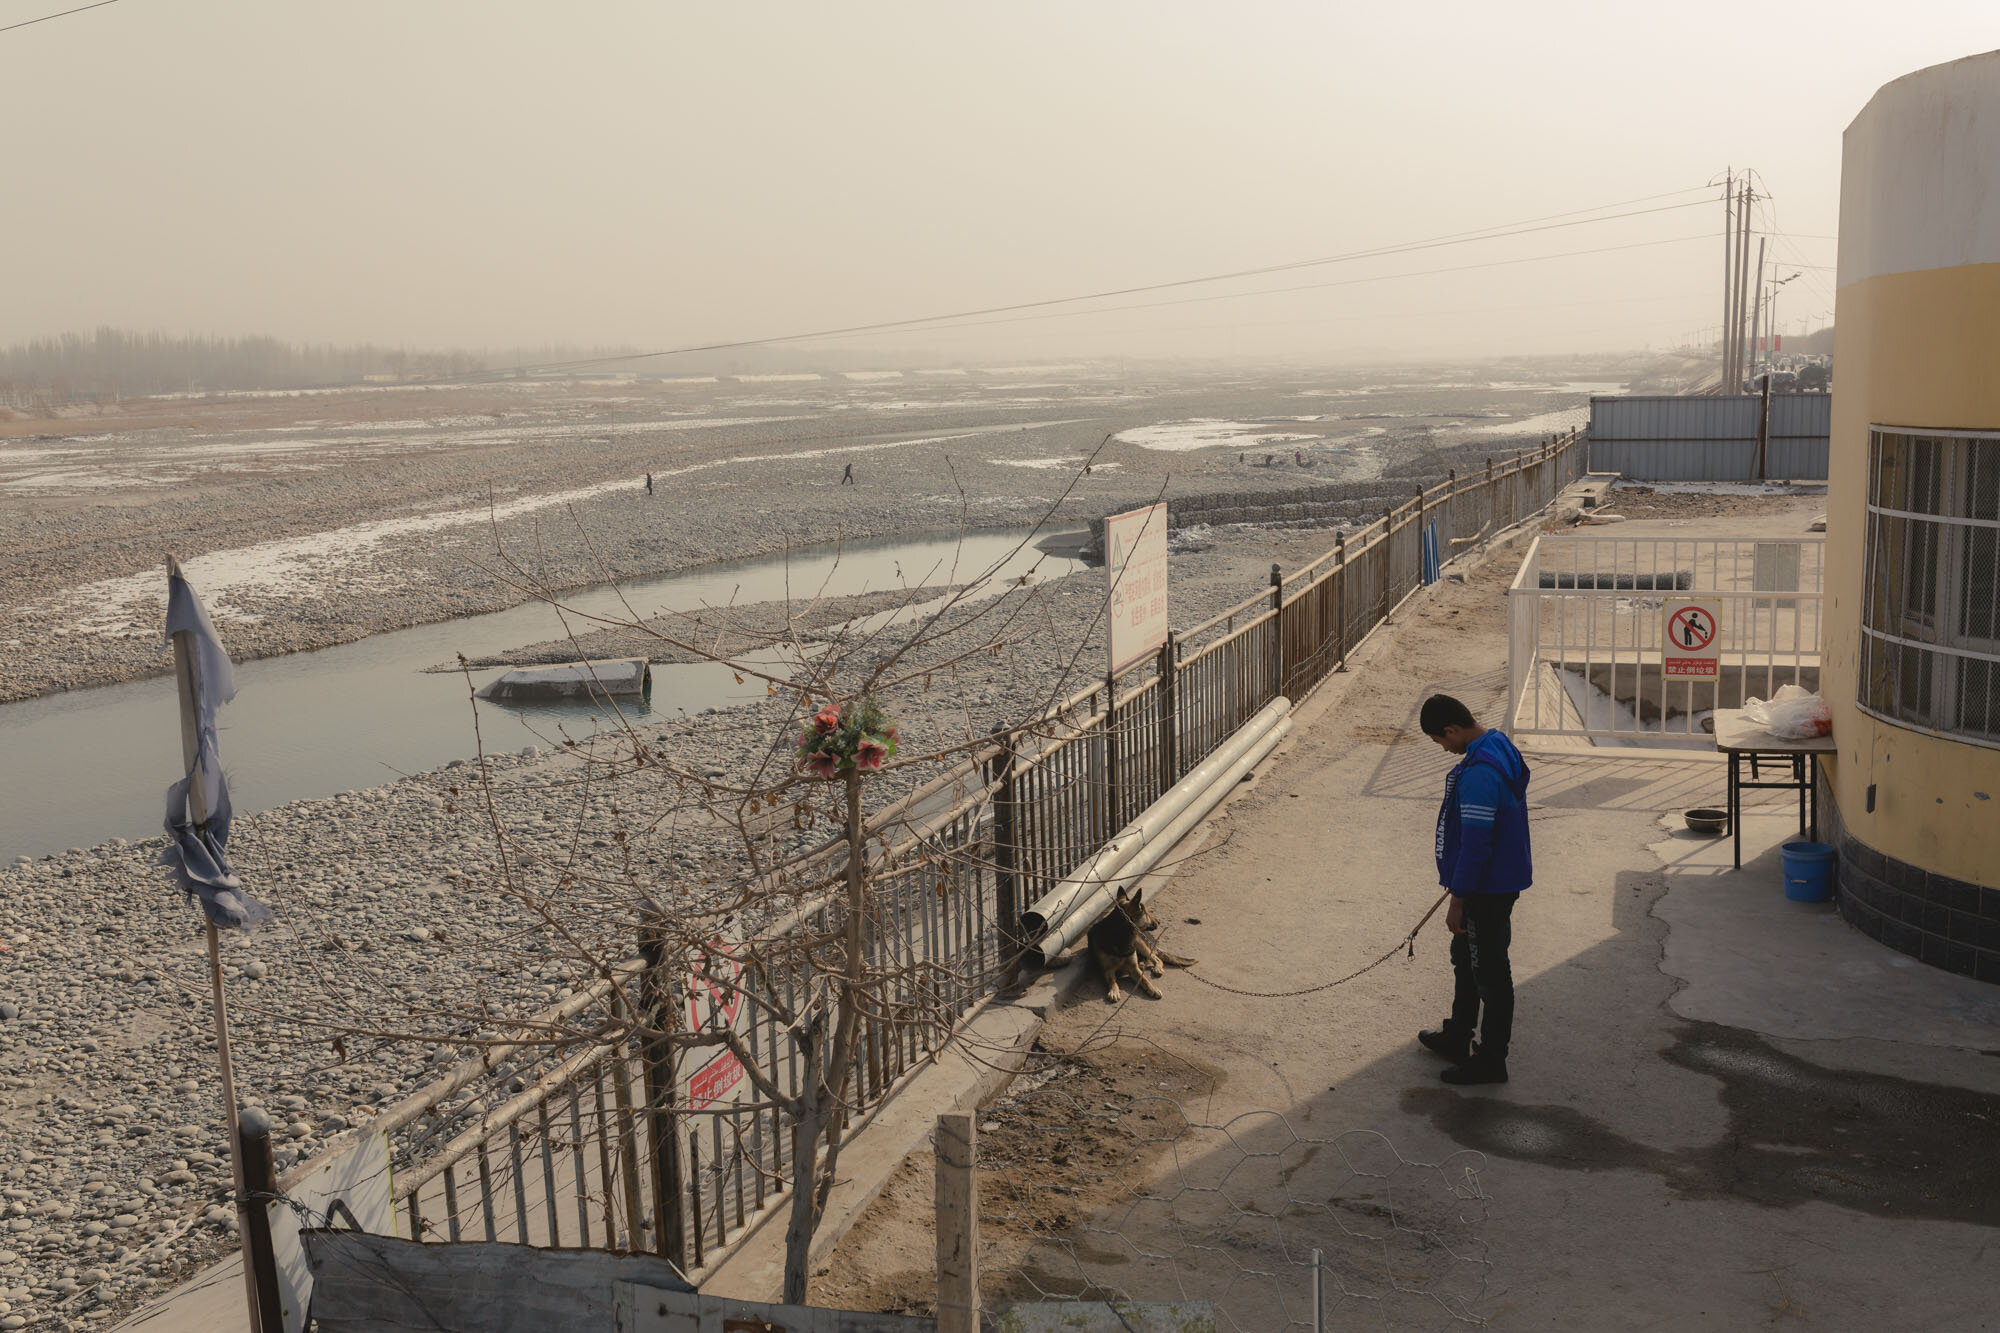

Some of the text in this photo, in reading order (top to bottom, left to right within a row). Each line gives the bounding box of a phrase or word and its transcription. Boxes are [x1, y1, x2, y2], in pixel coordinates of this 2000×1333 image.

[1668, 665, 1714, 674] 禁止倒垃圾
